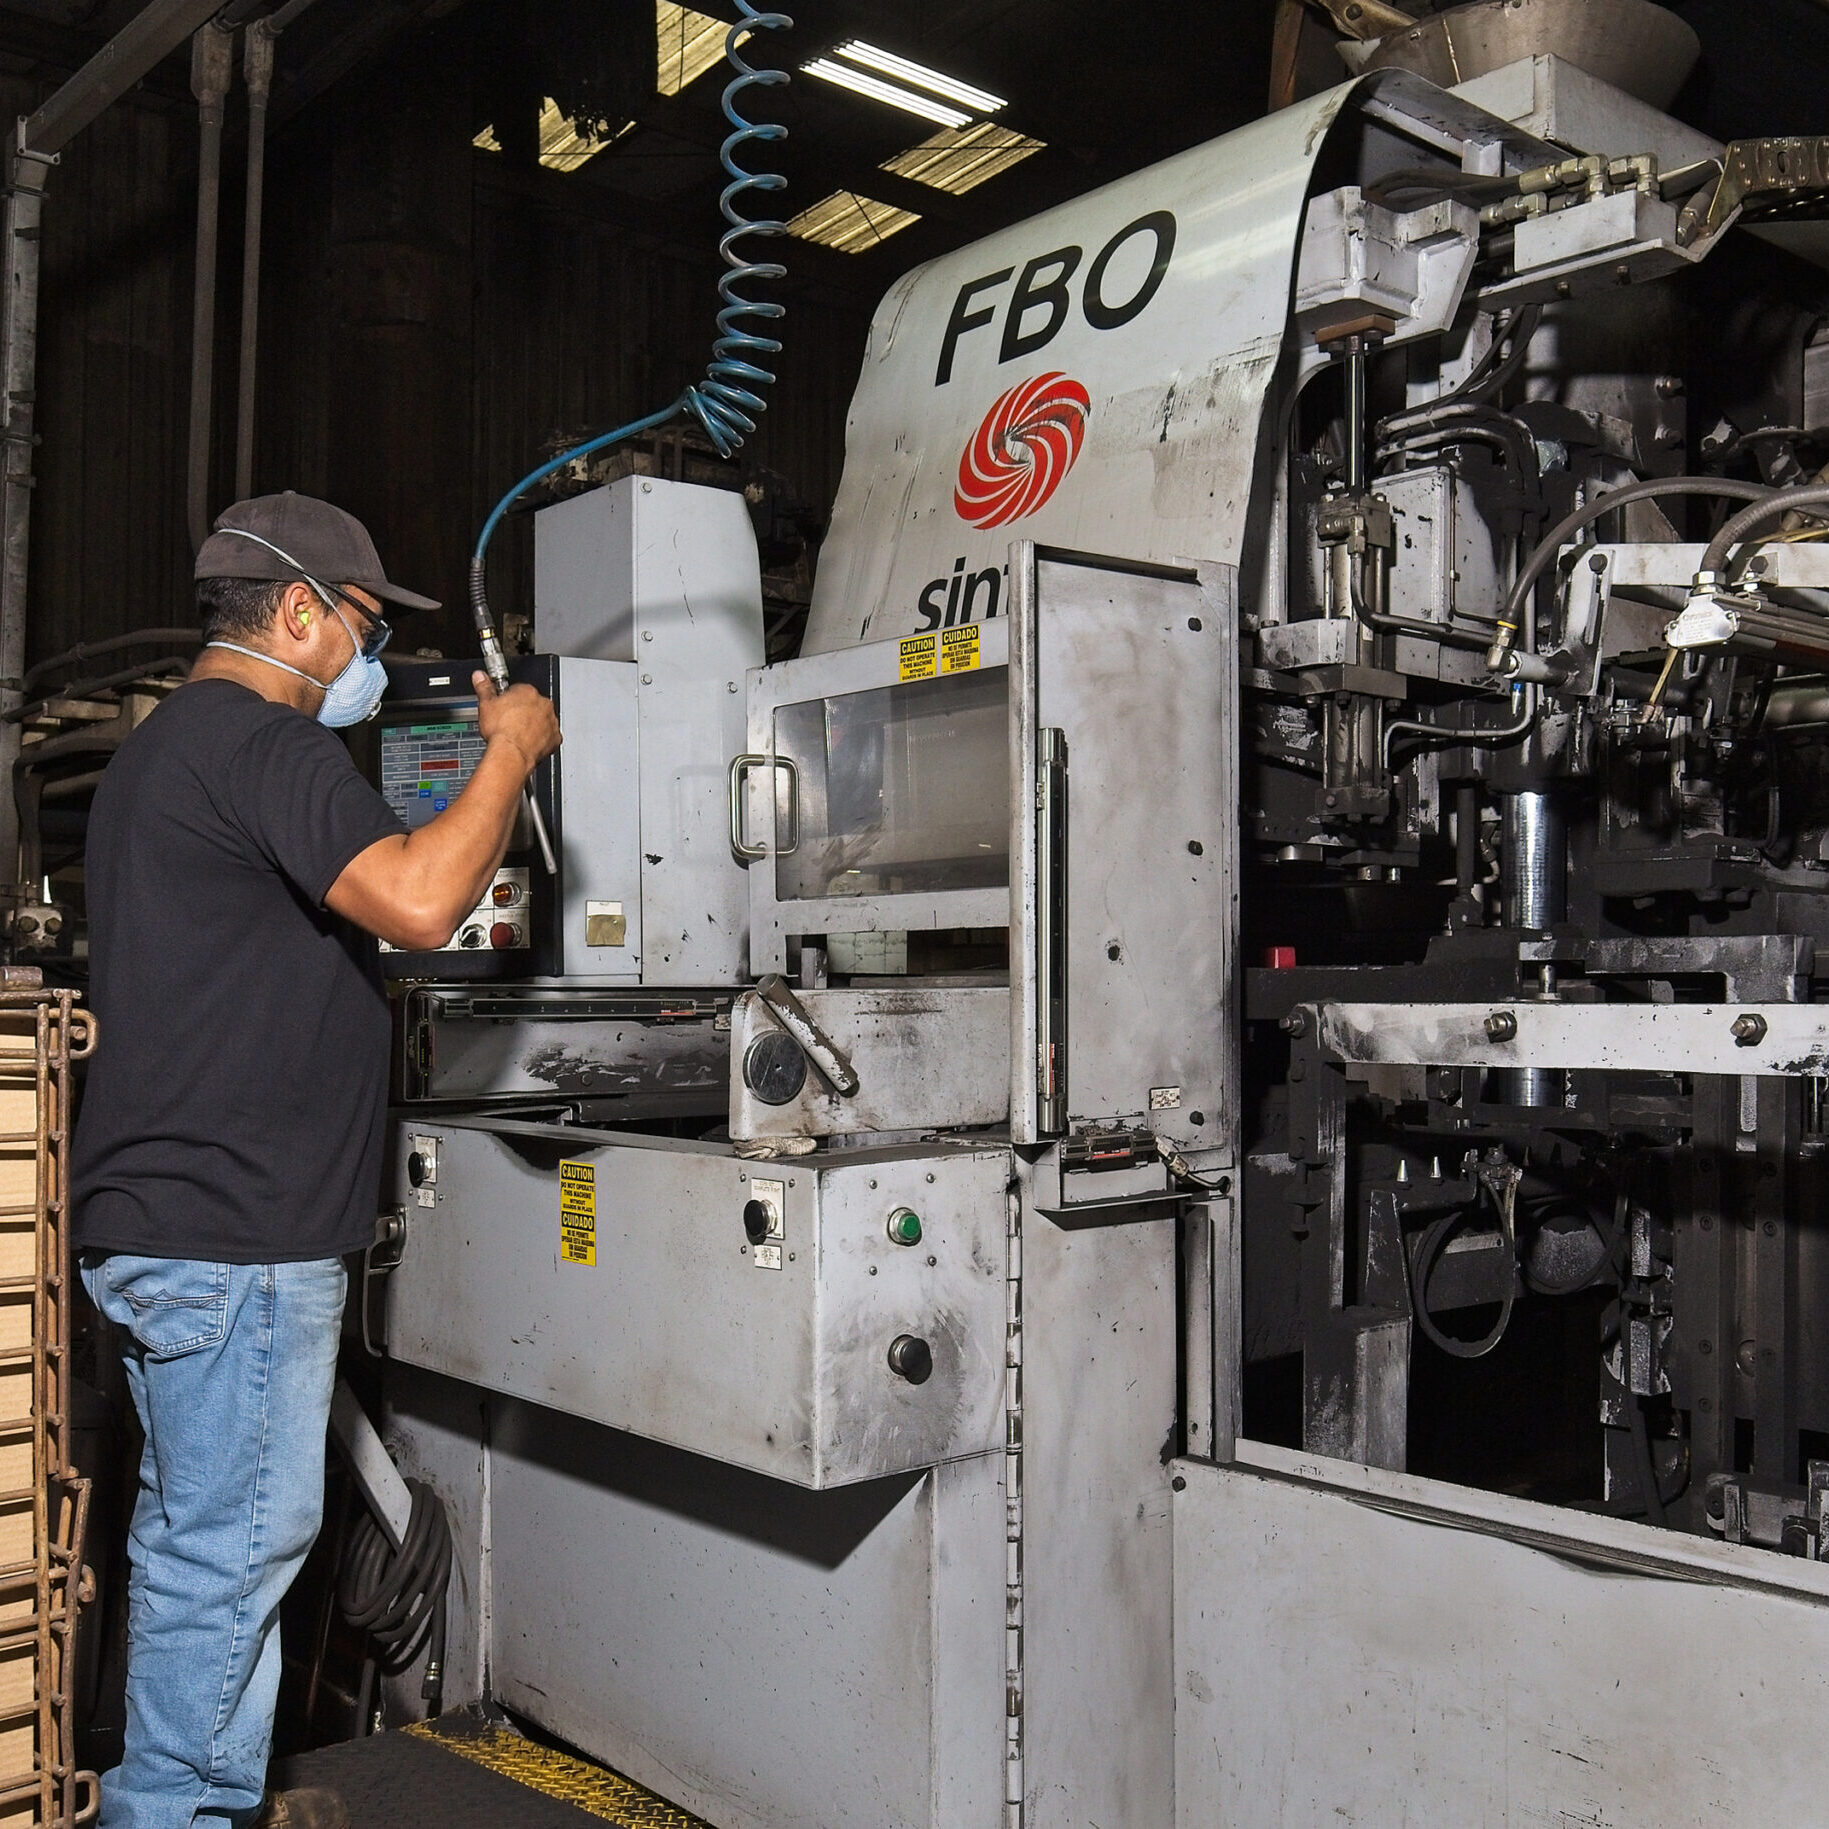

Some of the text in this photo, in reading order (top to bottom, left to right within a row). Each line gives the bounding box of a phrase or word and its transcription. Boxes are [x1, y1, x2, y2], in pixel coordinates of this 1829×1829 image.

[935, 210, 1177, 387] FBO
[914, 557, 1008, 633] sin
[943, 627, 977, 643] CUIDADO
[902, 638, 934, 655] CAUTION
[562, 1165, 593, 1181] CAUTION
[562, 1213, 594, 1230] CUIDADO
